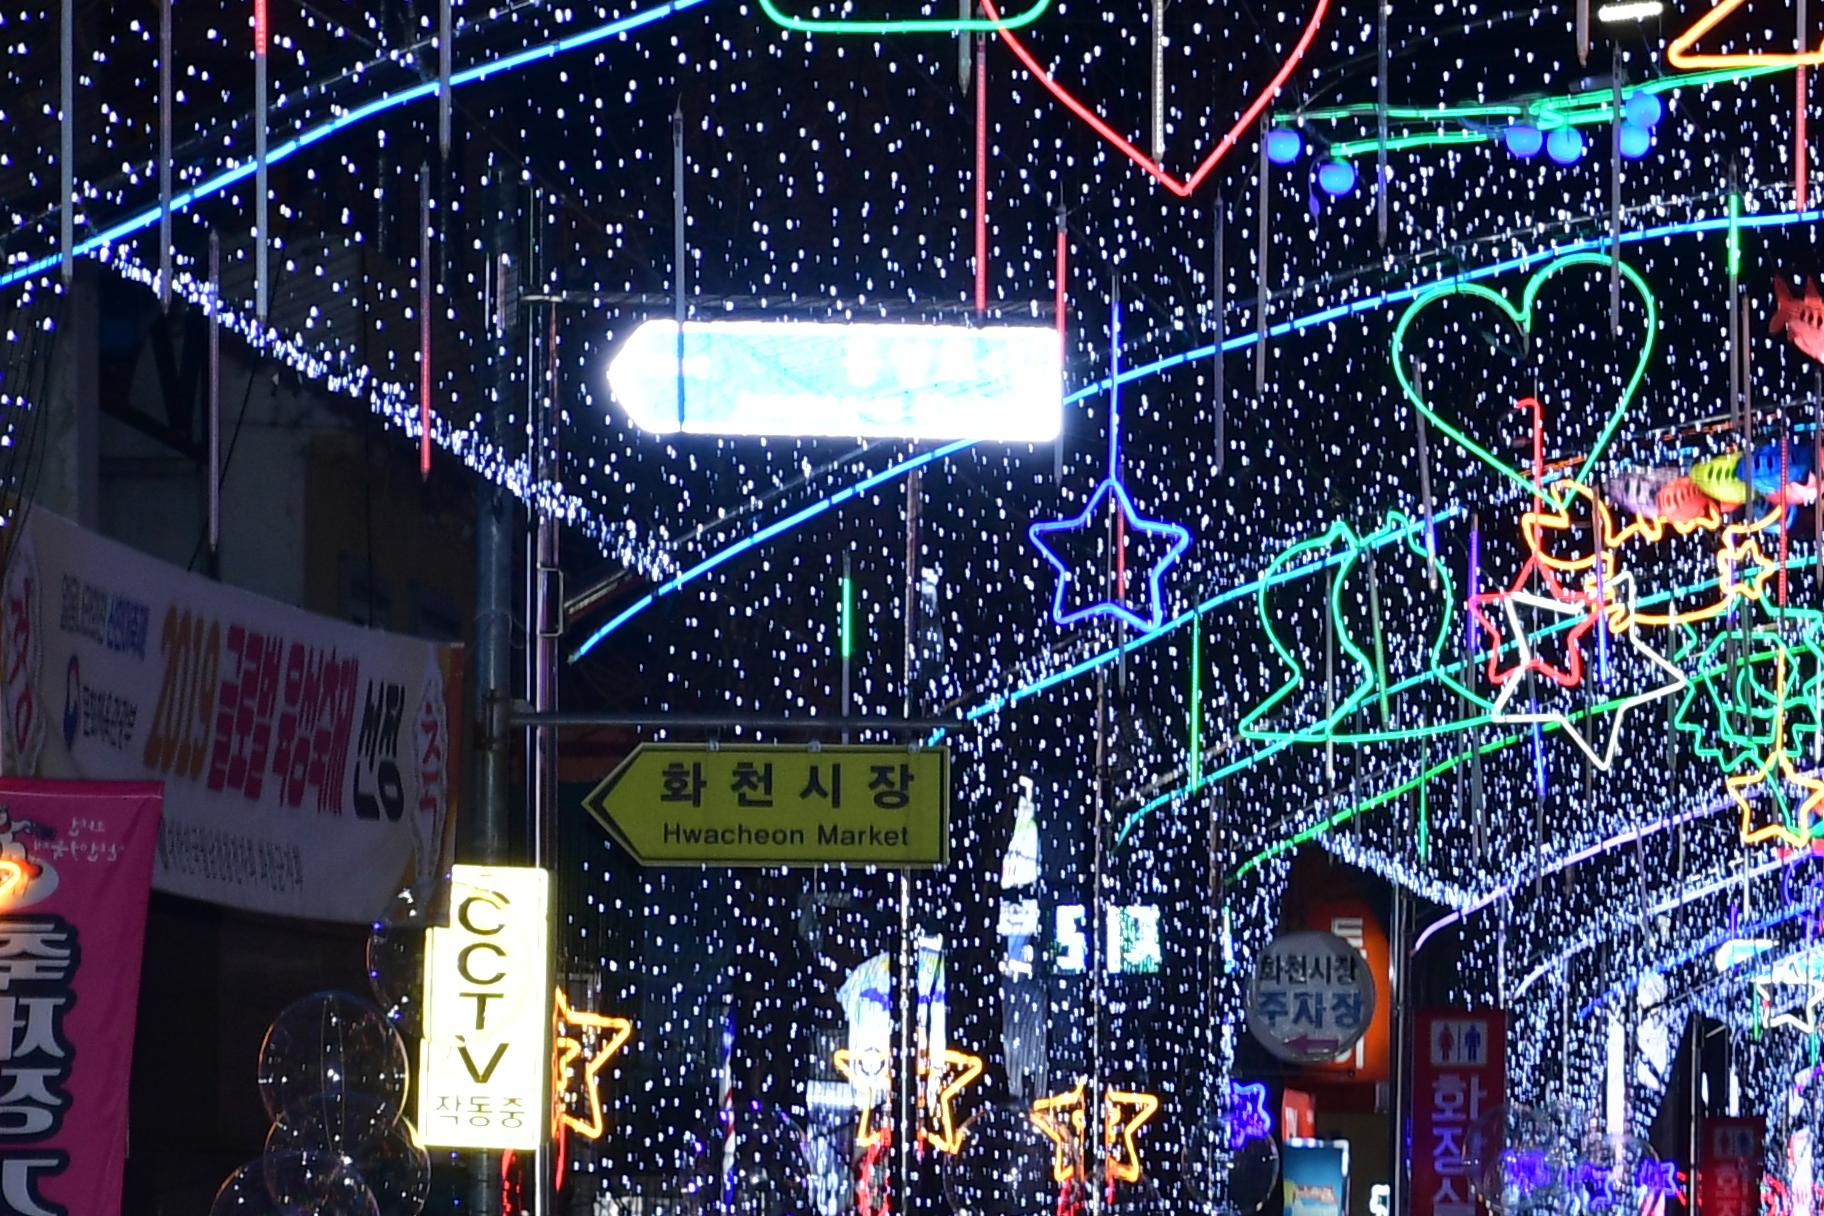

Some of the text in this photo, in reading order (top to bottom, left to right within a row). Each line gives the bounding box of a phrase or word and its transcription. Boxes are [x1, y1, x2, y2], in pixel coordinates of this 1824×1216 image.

[143, 604, 221, 782] 2019
[207, 624, 284, 800] 글로벌
[353, 677, 405, 822] 선정
[660, 761, 915, 810] 화천시장
[663, 823, 909, 847] Hwacheon Market
[456, 890, 511, 1084] CCTV
[1259, 954, 1357, 985] 화천시장
[435, 1095, 526, 1129] 작동중
